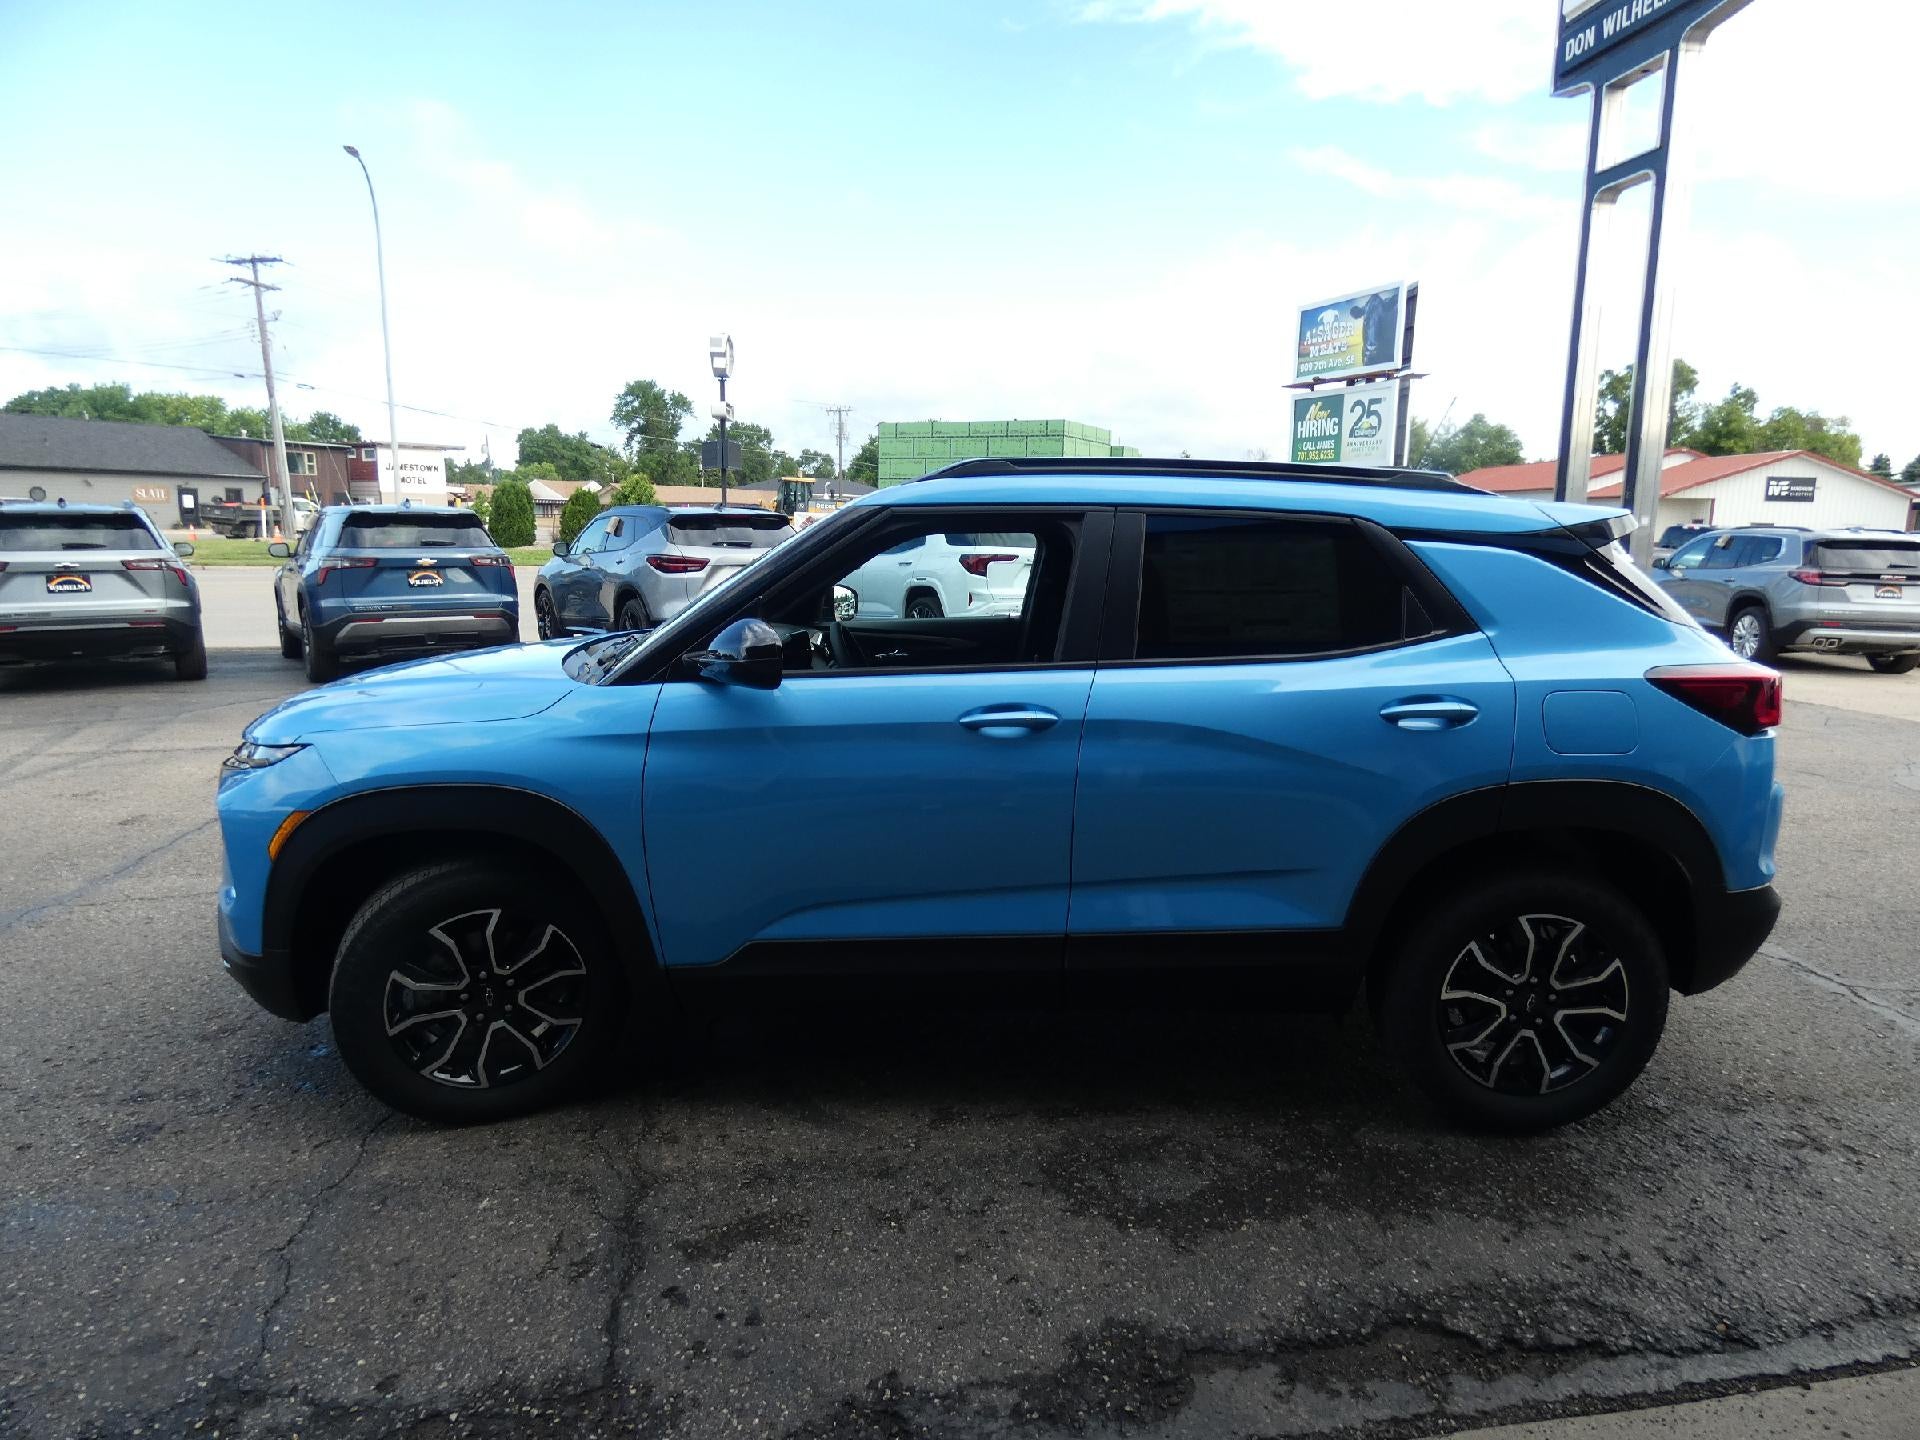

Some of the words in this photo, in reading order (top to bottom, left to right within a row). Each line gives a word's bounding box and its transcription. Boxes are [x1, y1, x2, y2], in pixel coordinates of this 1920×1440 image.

[1565, 26, 1596, 62] DON
[1602, 0, 1671, 39] WILHEL
[1309, 341, 1348, 358] MEATS
[1345, 355, 1355, 365] SE
[1297, 417, 1339, 439] HIRING
[1302, 441, 1316, 451] CALL
[1316, 440, 1335, 450] JAMES
[385, 463, 439, 473] JMESTOWN
[400, 476, 427, 485] MOTEL
